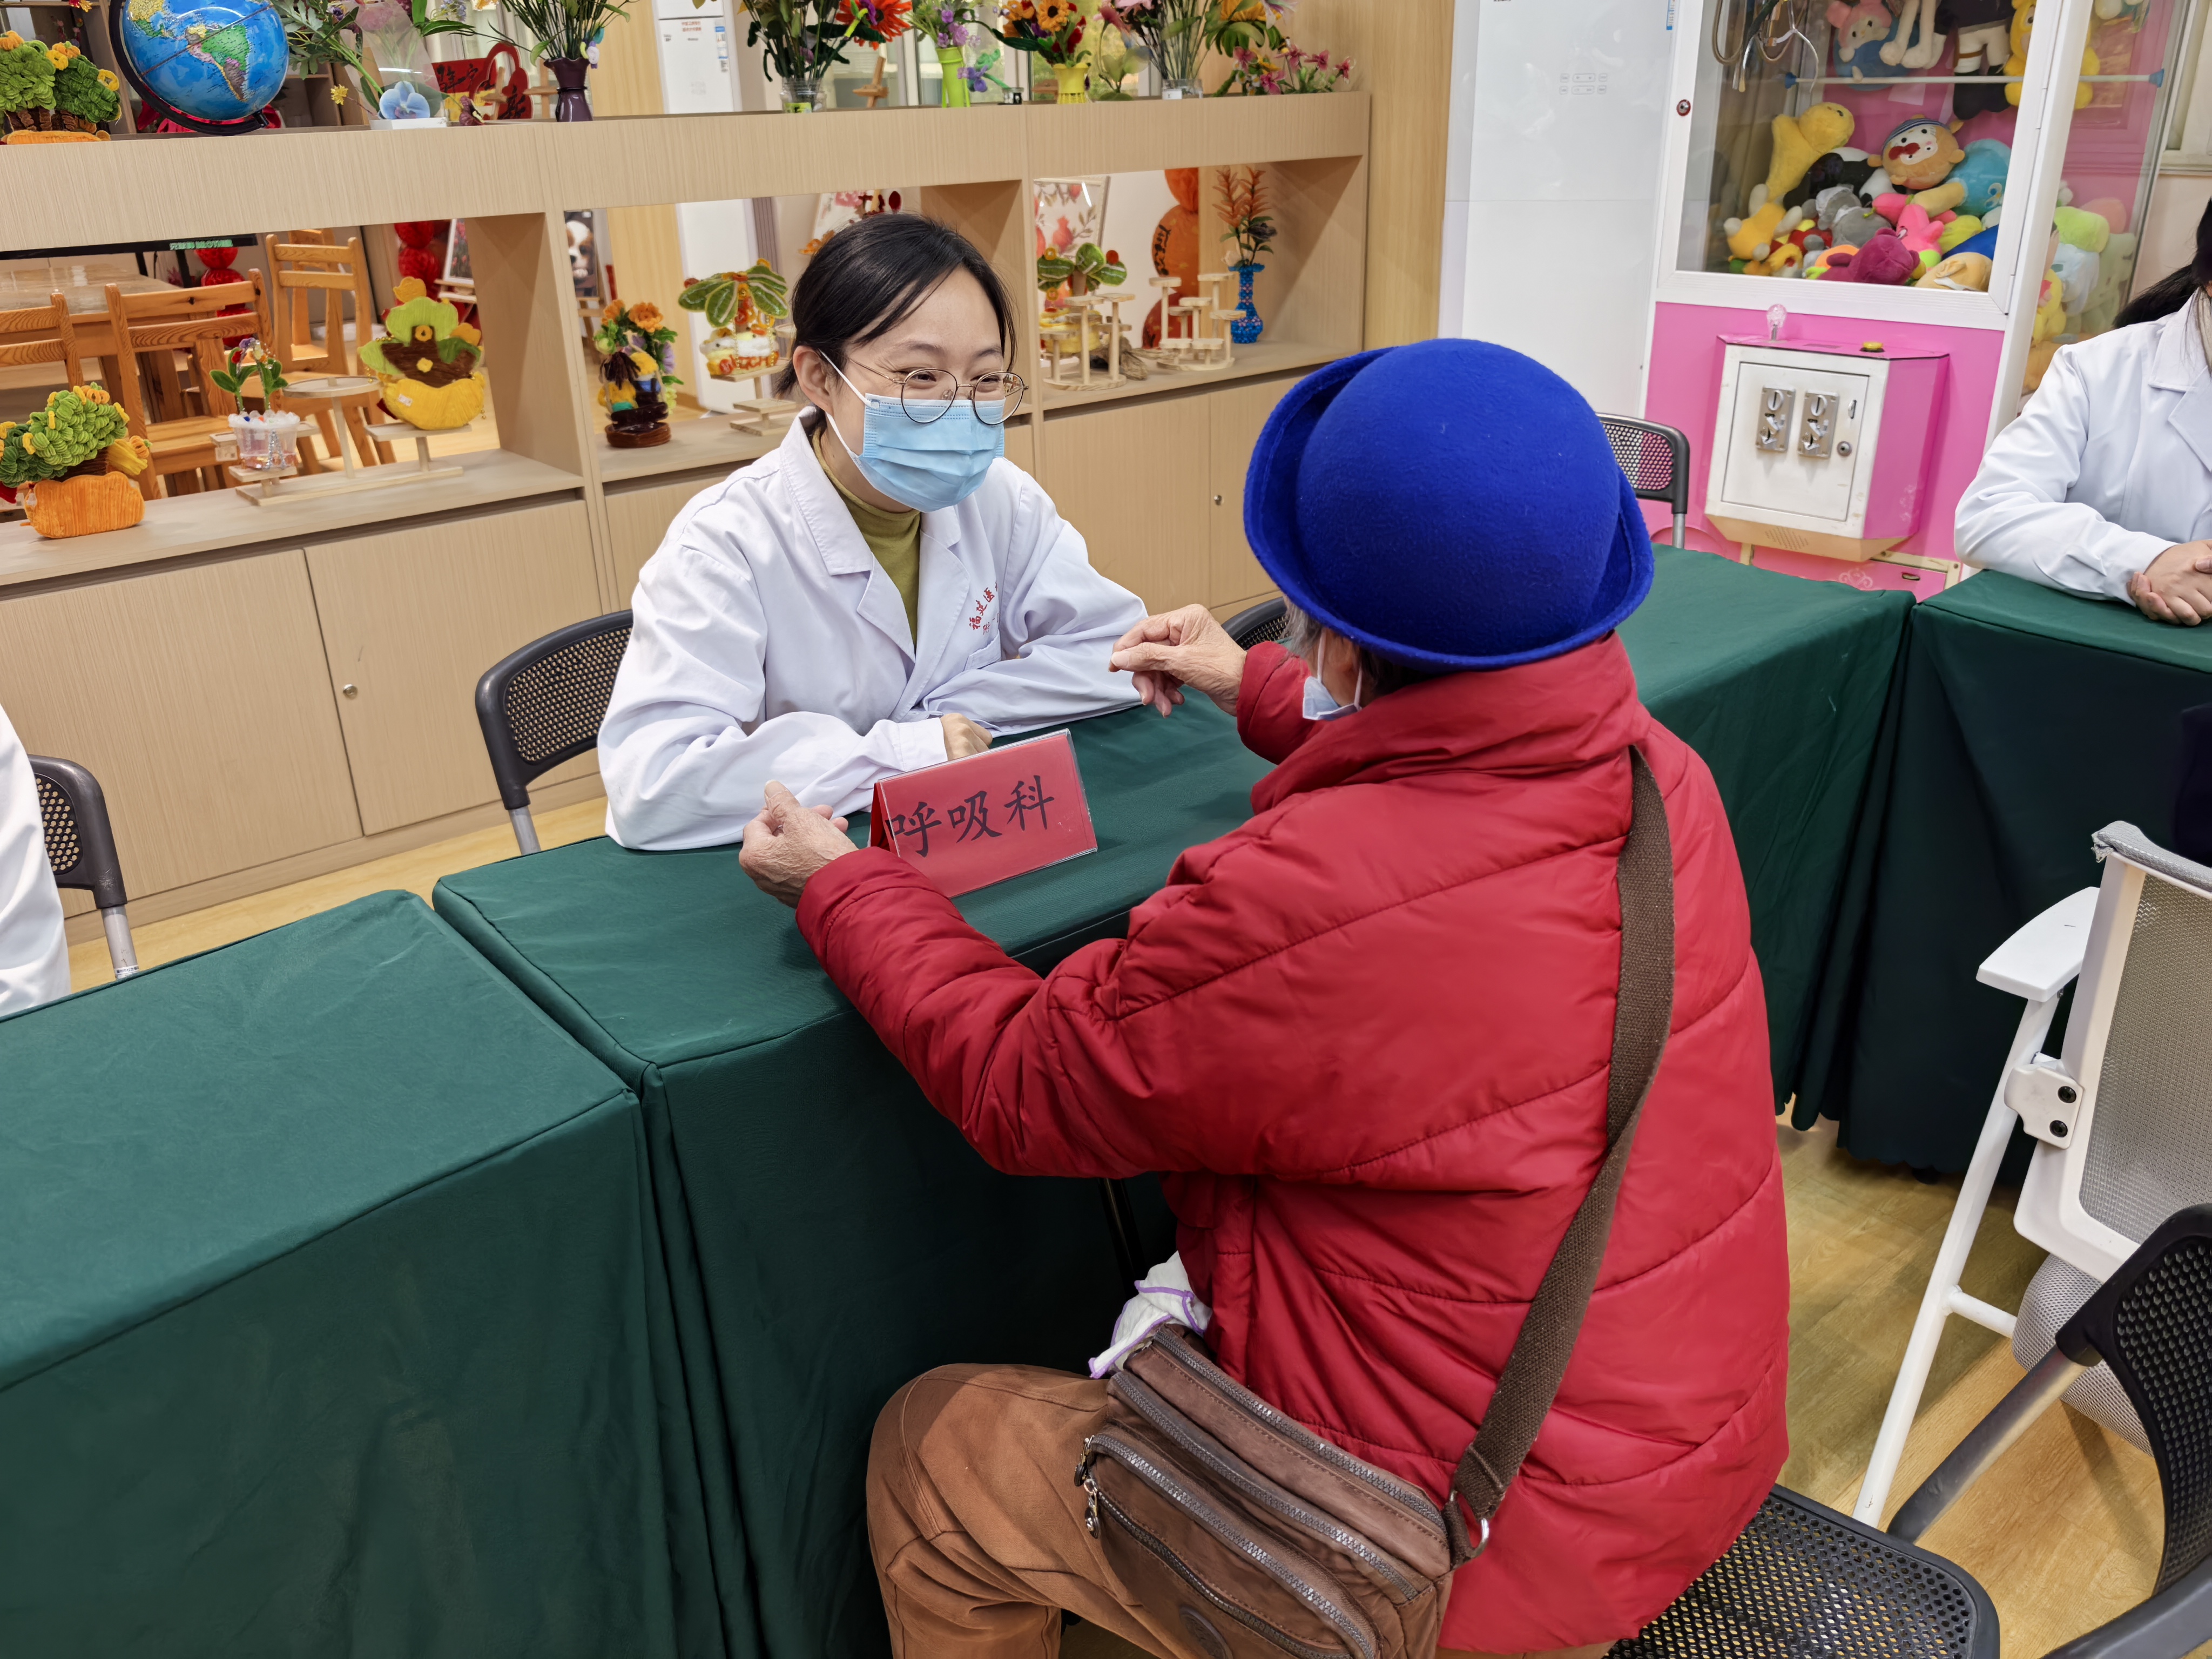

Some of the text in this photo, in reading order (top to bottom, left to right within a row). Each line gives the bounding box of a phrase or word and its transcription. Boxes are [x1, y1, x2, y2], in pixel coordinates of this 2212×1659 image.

[969, 581, 998, 631] 福建医
[885, 774, 1055, 858] 呼吸科
